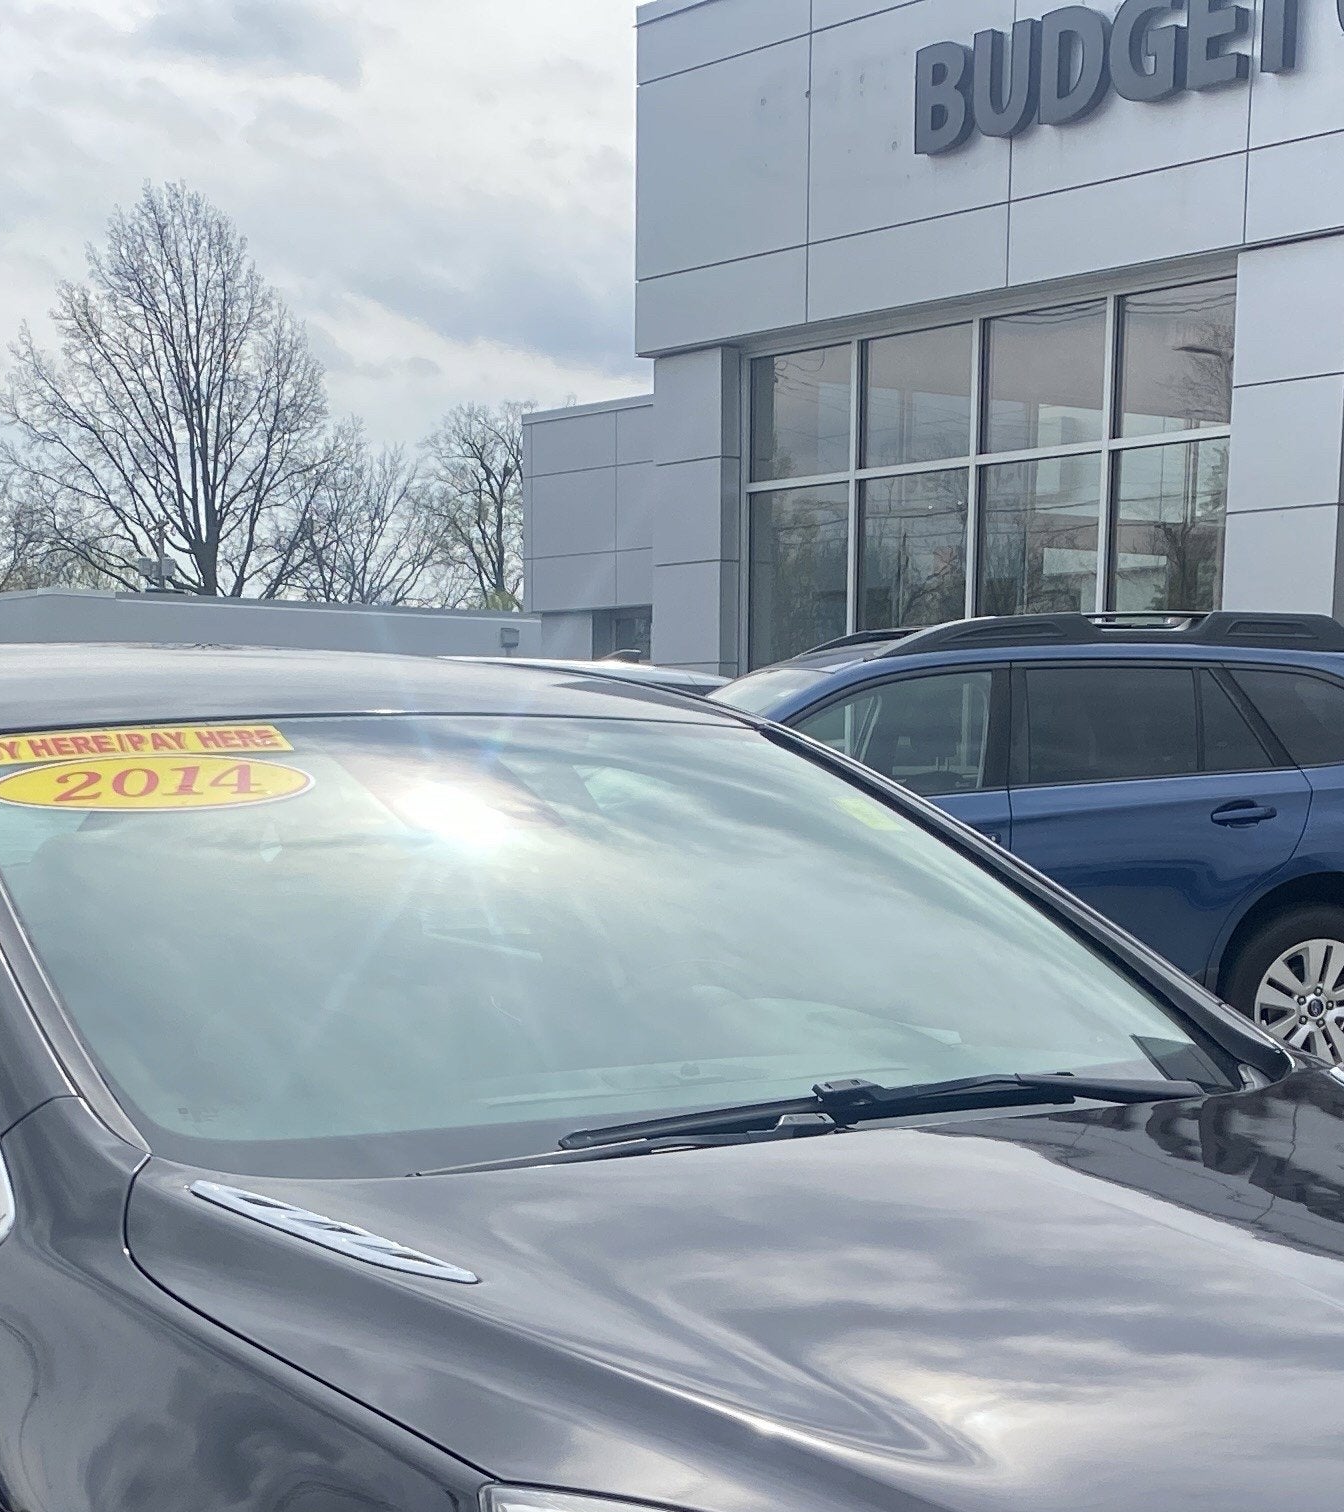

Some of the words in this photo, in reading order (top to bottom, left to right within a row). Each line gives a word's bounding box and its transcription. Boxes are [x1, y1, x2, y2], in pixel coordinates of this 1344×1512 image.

[914, 0, 1301, 154] BUDGET
[29, 729, 188, 757] HERE/PAY
[195, 728, 283, 750] HERE
[53, 764, 268, 803] 2014
